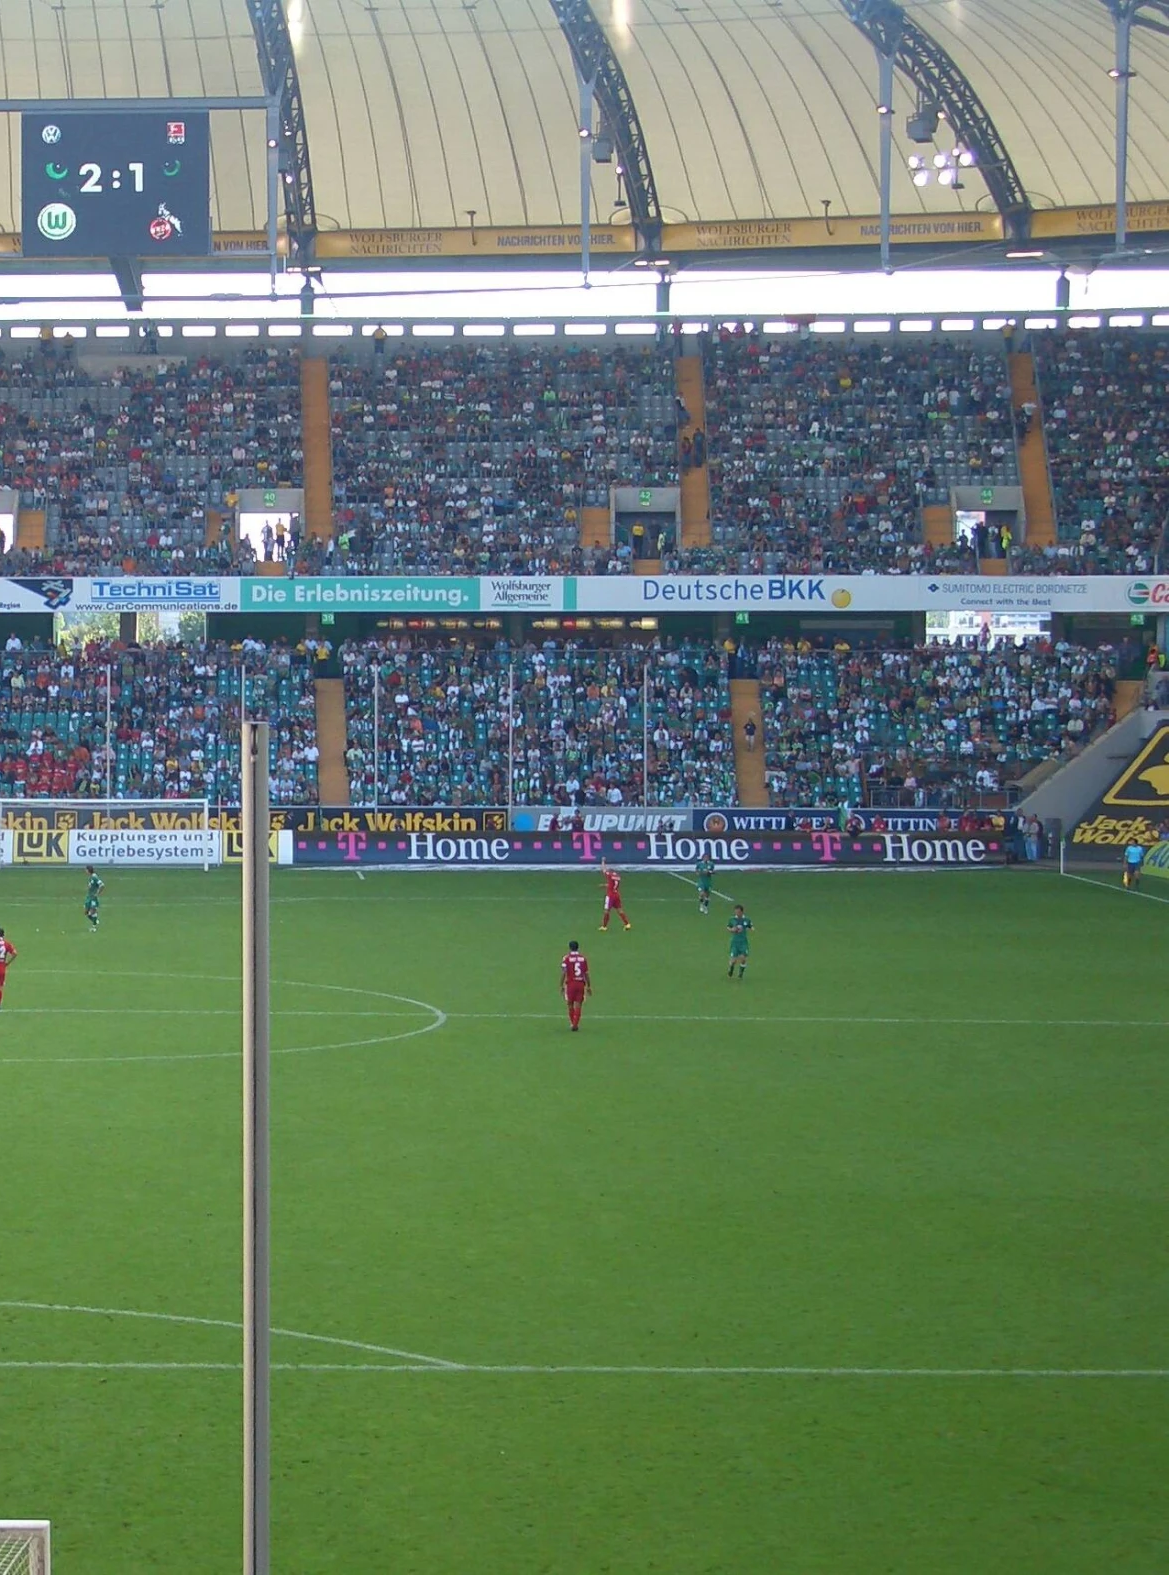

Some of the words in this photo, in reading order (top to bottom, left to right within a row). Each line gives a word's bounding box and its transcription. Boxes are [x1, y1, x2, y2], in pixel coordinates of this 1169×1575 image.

[349, 232, 443, 244] WOLFSBURGER
[497, 234, 564, 246] NACHRICHTEN
[92, 581, 219, 597] TechniSat
[491, 580, 551, 592] Wolfsburger
[941, 583, 991, 594] SUMITOMO
[993, 583, 1034, 594] ELECTRIC
[251, 585, 287, 602] Die
[295, 584, 469, 607] Erlebniszeitung.
[493, 591, 549, 602] Allgemeine
[960, 597, 993, 606] Connect
[995, 597, 1014, 605] with
[1016, 597, 1029, 605] the
[1031, 597, 1052, 606] Best
[75, 602, 238, 611] www.CarCommunications.de
[84, 812, 146, 830] Jack
[298, 812, 360, 831] Jack
[364, 812, 477, 831] Wolfskin
[1079, 814, 1152, 831] Jack
[76, 832, 179, 843] Kupplungen
[406, 833, 510, 861] Home
[646, 833, 750, 861] Home
[882, 833, 986, 862] Home
[574, 963, 581, 976] 5
